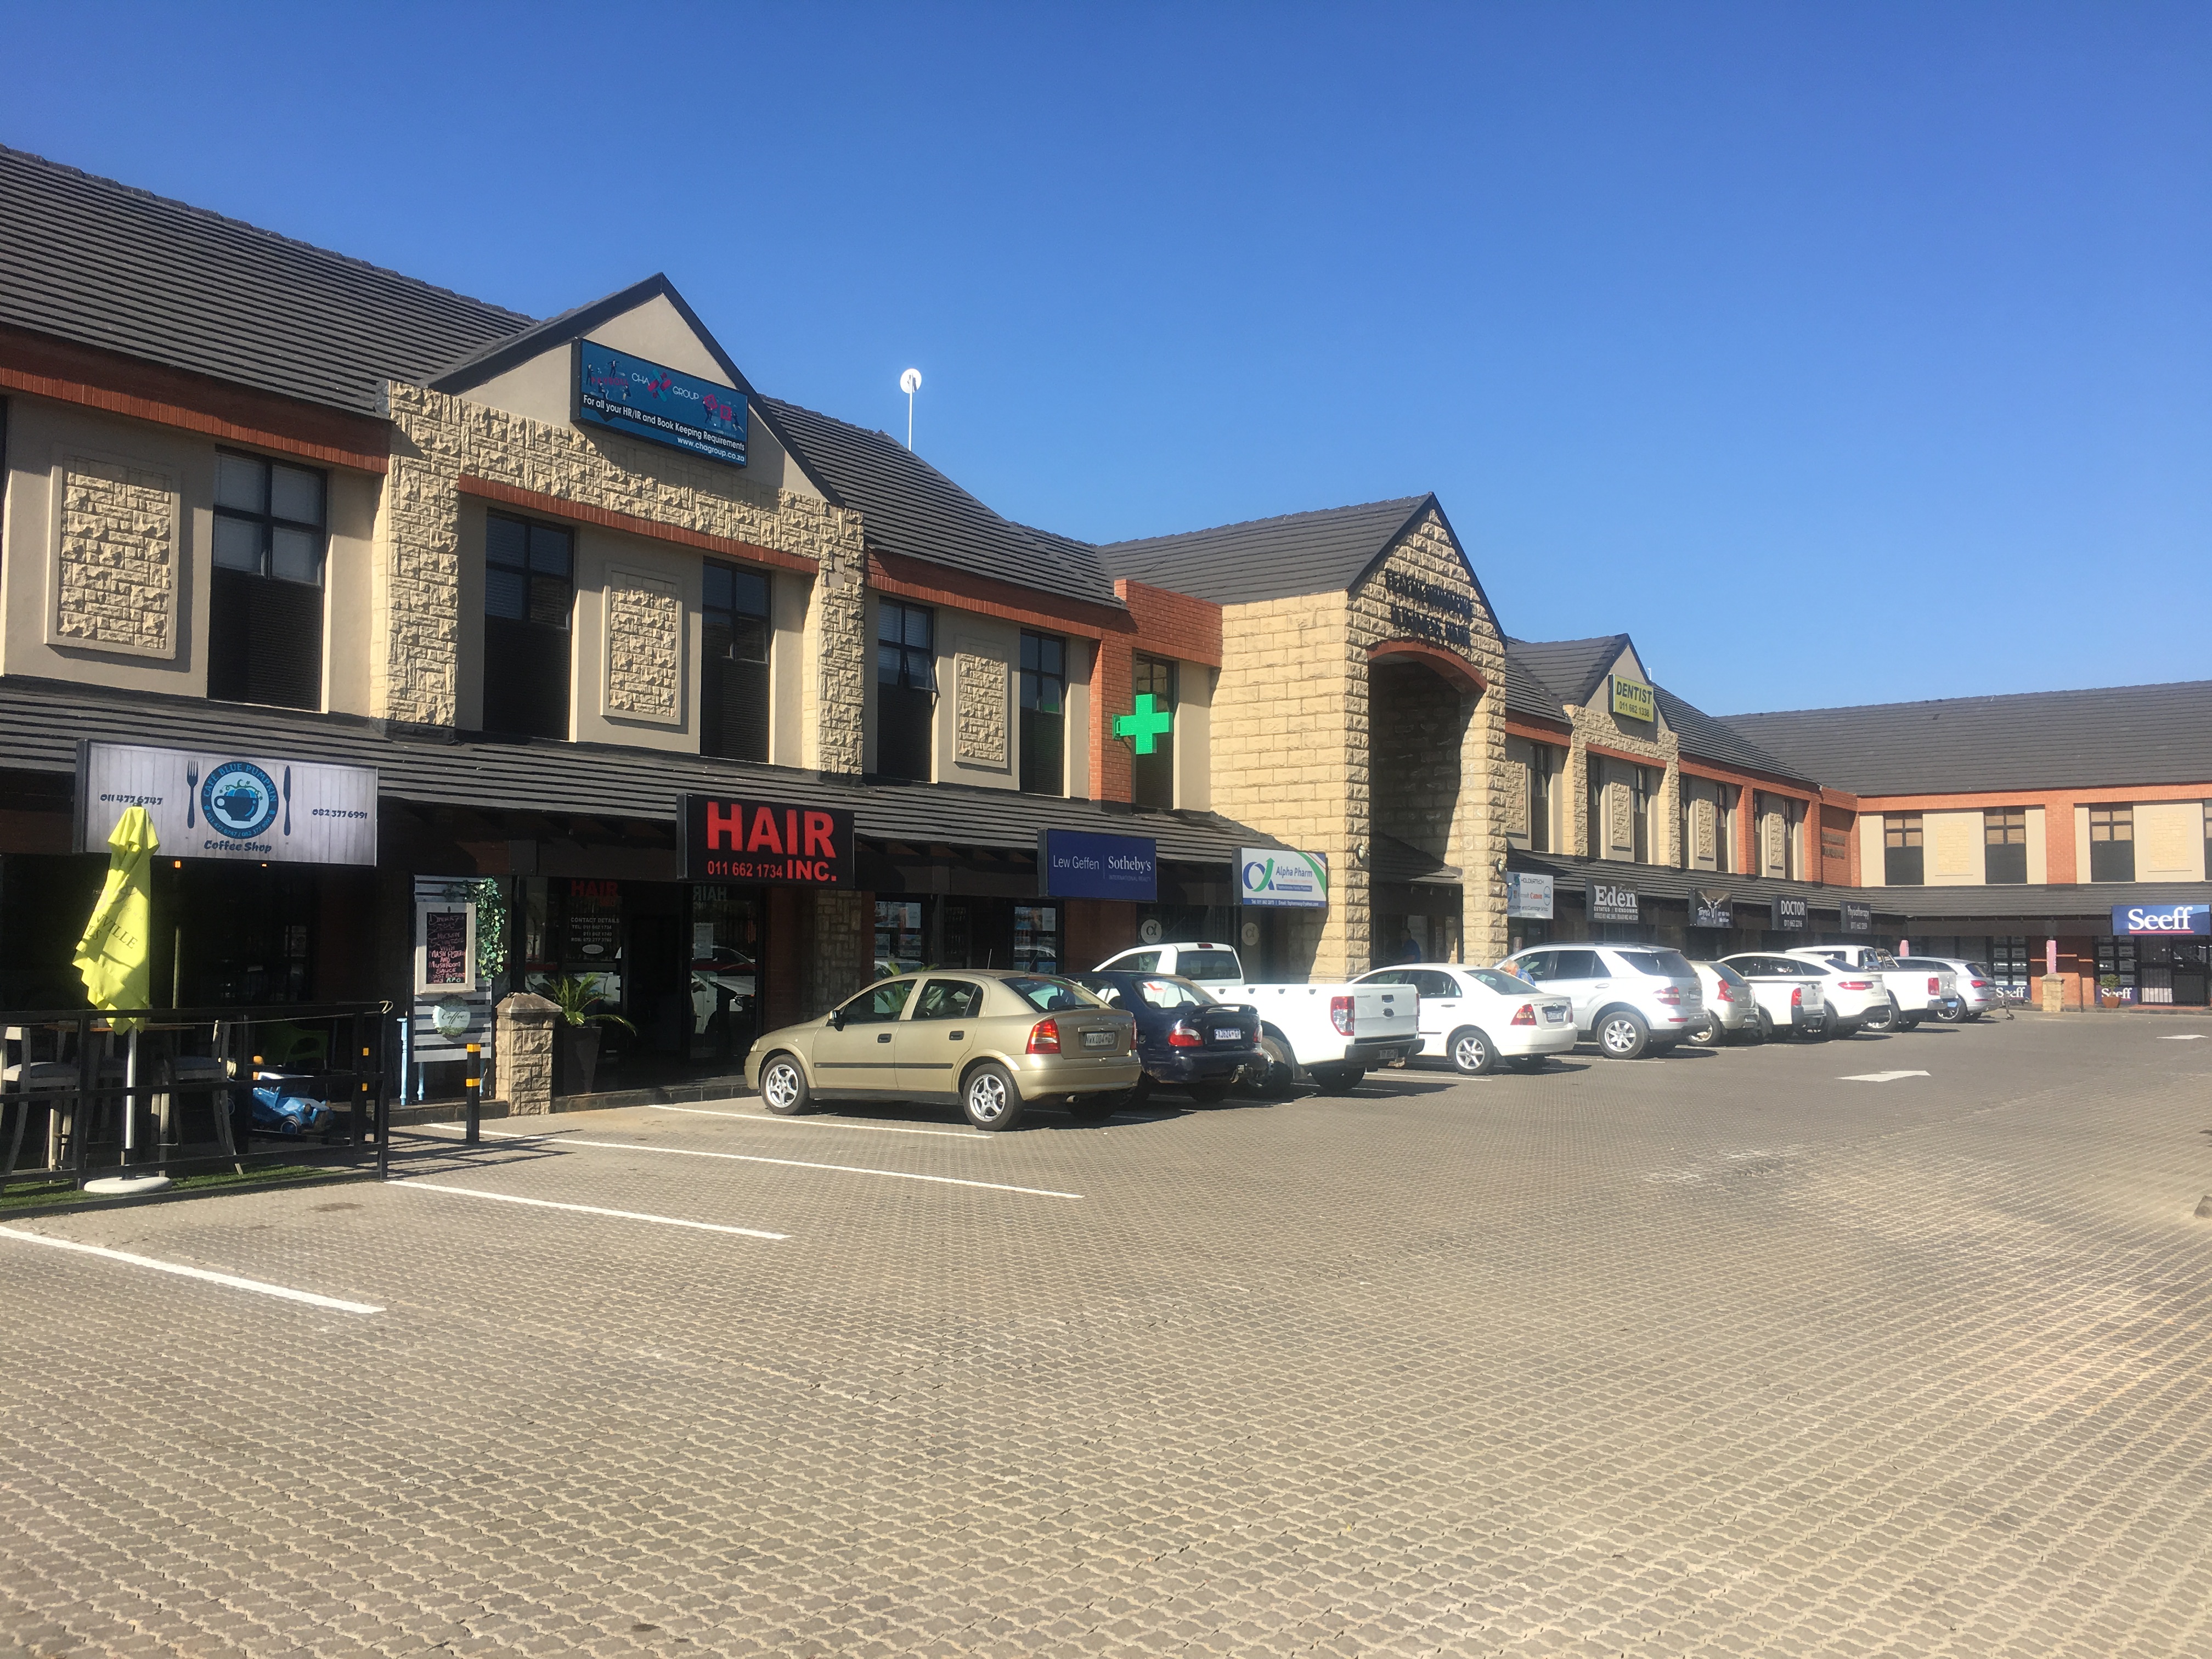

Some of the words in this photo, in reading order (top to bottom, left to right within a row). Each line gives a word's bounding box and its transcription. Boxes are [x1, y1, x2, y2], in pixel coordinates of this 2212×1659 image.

[631, 373, 650, 386] CHA
[672, 386, 699, 400] GROUP
[583, 394, 594, 405] For
[596, 400, 605, 409] all
[606, 403, 622, 413] your
[623, 407, 641, 420] HR/IR
[642, 415, 656, 425] and
[657, 416, 674, 430] Book
[675, 422, 702, 440] Keeping
[703, 431, 745, 451] Requirements
[677, 437, 745, 462] www.chagroup.co.za
[1616, 681, 1652, 704] DENTIST
[1619, 701, 1628, 711] 011
[1629, 703, 1638, 714] 662
[204, 774, 219, 797] CAFÉ
[218, 763, 242, 775] BLUE
[245, 764, 277, 802] PUMPKIN
[116, 794, 136, 803] 477
[137, 795, 163, 805] 6747
[312, 808, 330, 816] 082
[331, 809, 347, 819] 377
[348, 810, 368, 820] 6991
[707, 800, 837, 858] HAIR
[204, 840, 242, 851] Coffee
[244, 841, 272, 854] Shop
[708, 860, 727, 875] 011
[732, 861, 753, 877] 662
[757, 863, 783, 878] 1734
[786, 859, 837, 882] INC.
[1053, 855, 1070, 868] Lew
[1072, 856, 1099, 870] Geffen
[1108, 855, 1152, 874] Sotheby's
[1276, 866, 1293, 878] Alpha
[1294, 867, 1313, 878] Pharm
[571, 879, 618, 896] HAIR
[1593, 885, 1638, 907] Eden
[1781, 900, 1805, 916] DOCTOR
[2128, 906, 2193, 930] Seeff
